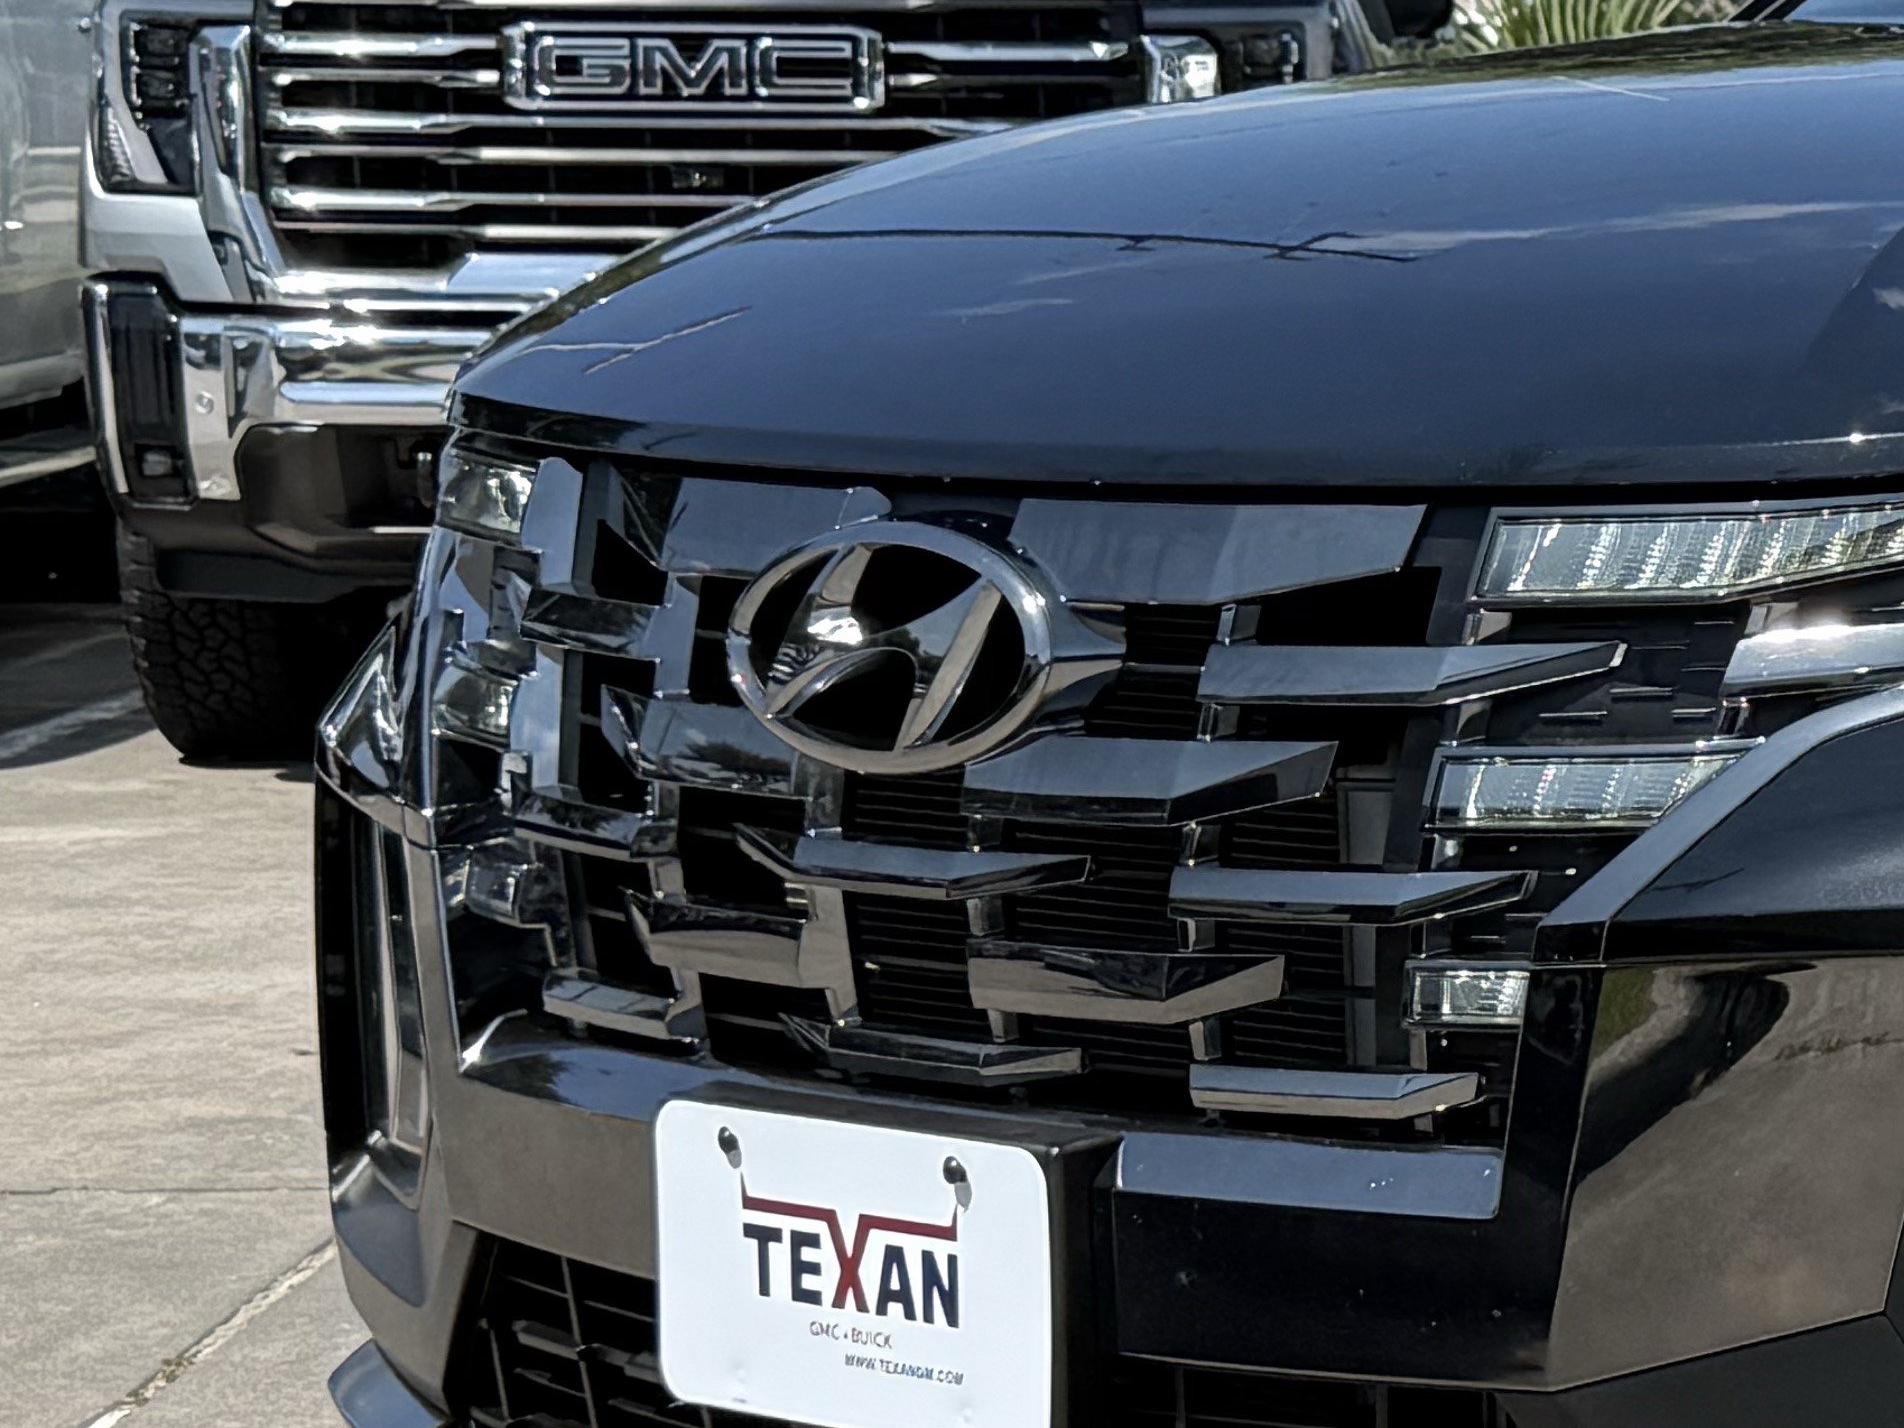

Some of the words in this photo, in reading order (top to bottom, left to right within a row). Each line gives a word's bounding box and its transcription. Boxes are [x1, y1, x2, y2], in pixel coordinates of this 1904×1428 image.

[534, 36, 853, 98] GMC
[742, 1172, 960, 1330] TEXAN
[809, 1320, 840, 1341] GMC
[851, 1326, 893, 1350] BUICK
